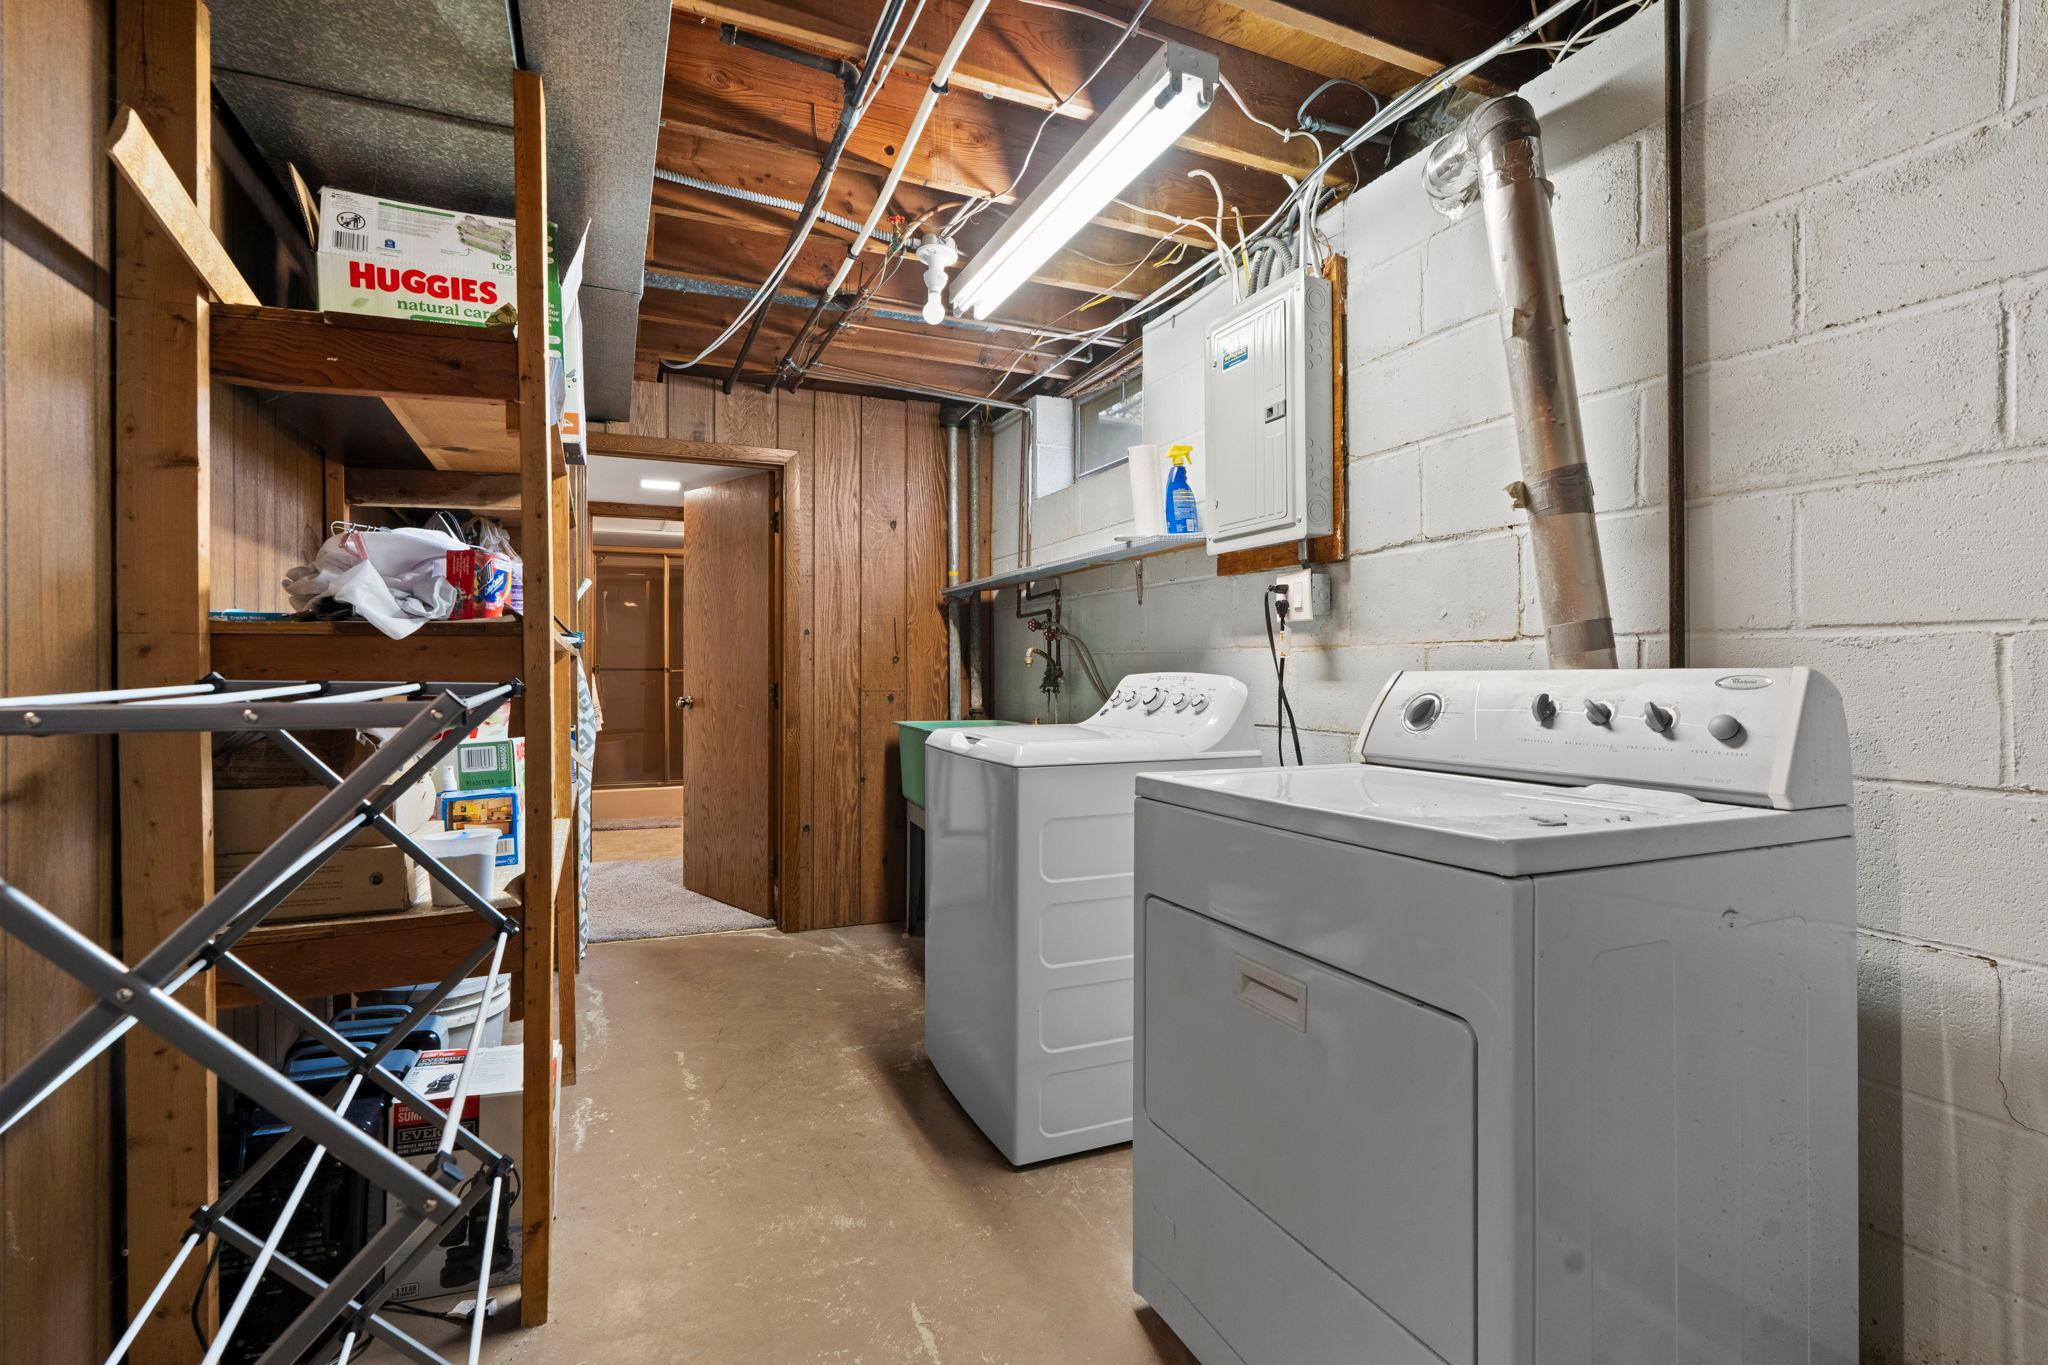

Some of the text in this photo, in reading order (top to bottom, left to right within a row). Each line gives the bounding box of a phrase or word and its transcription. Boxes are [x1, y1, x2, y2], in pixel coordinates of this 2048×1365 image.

[349, 261, 498, 305] HUGGIES
[397, 299, 459, 316] natural
[398, 1111, 422, 1122] SUM
[400, 1285, 417, 1294] YEAR
